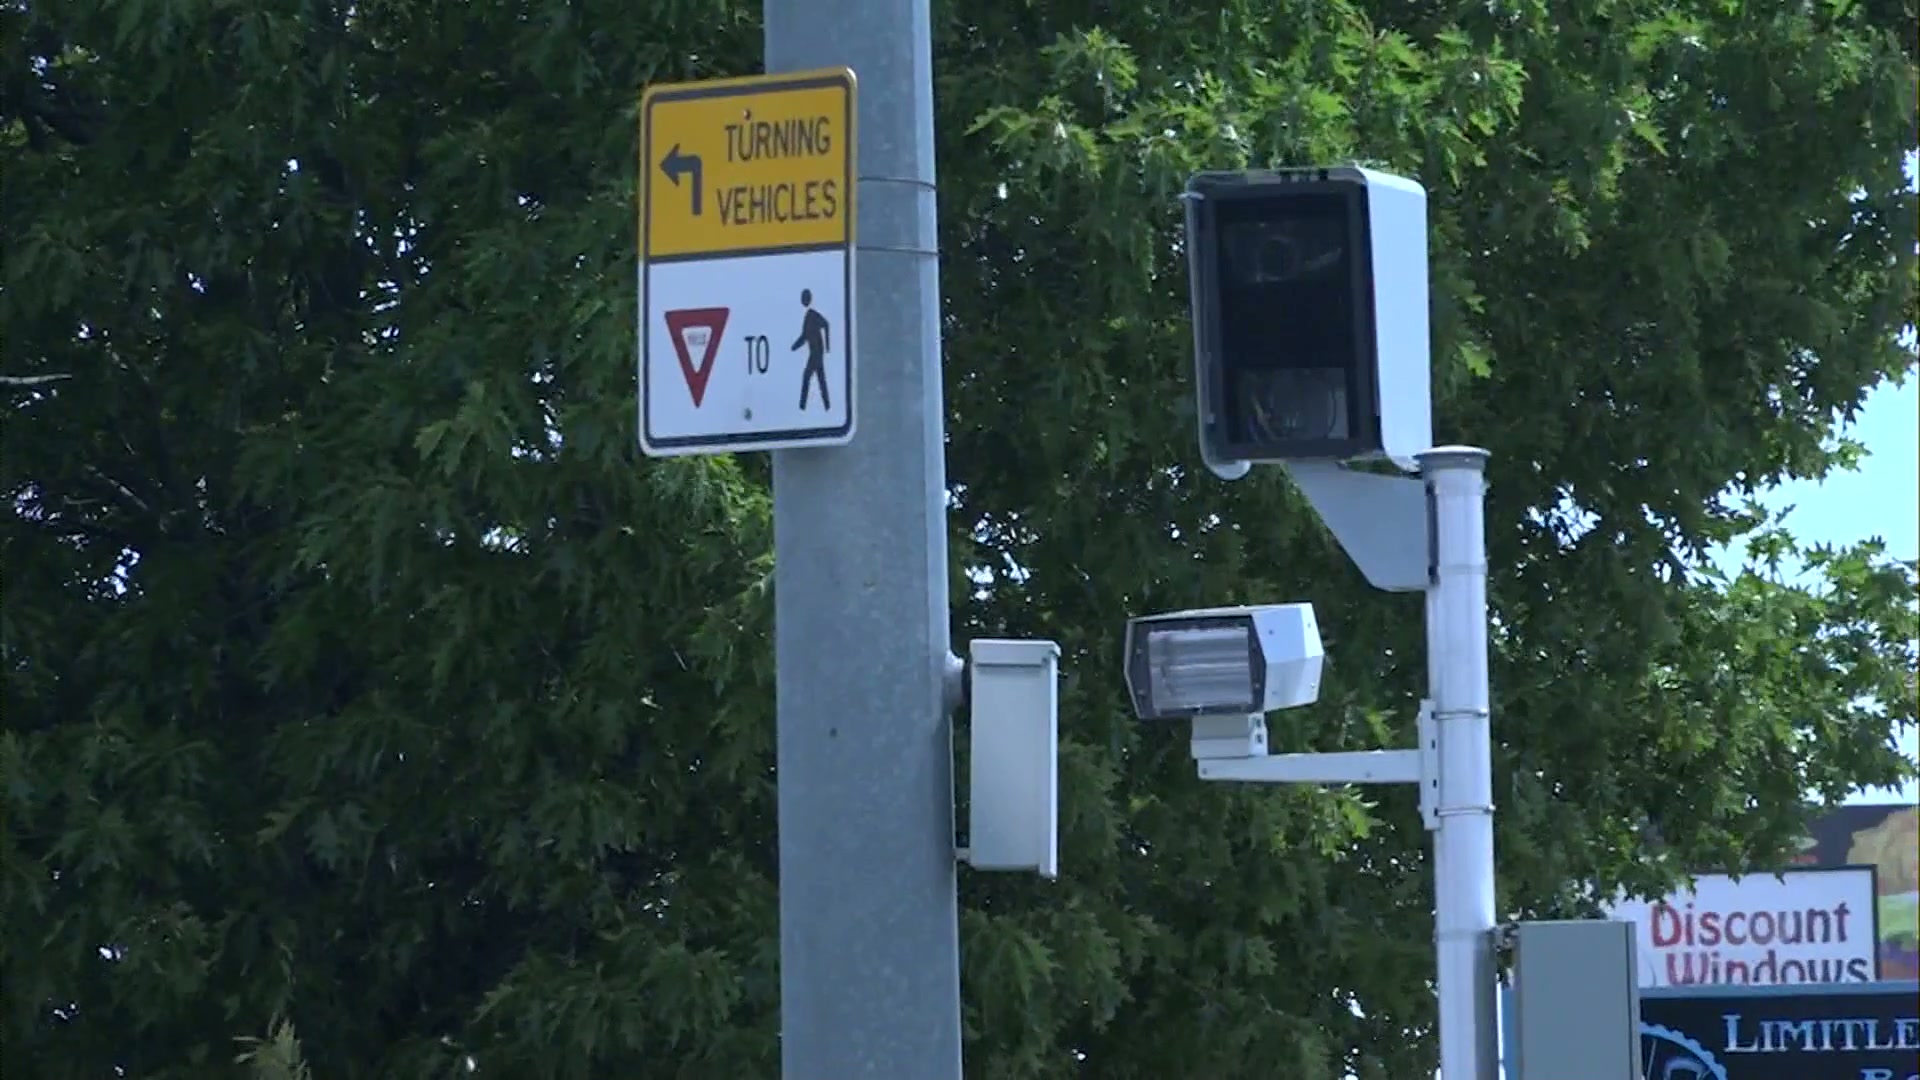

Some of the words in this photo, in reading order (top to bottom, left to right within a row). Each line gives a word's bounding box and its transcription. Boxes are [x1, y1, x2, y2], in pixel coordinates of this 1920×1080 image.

[725, 117, 831, 162] TURNING
[717, 179, 836, 226] VEHICLES
[744, 335, 770, 374] TO
[1652, 902, 1850, 947] Discount
[1667, 949, 1868, 985] Windows
